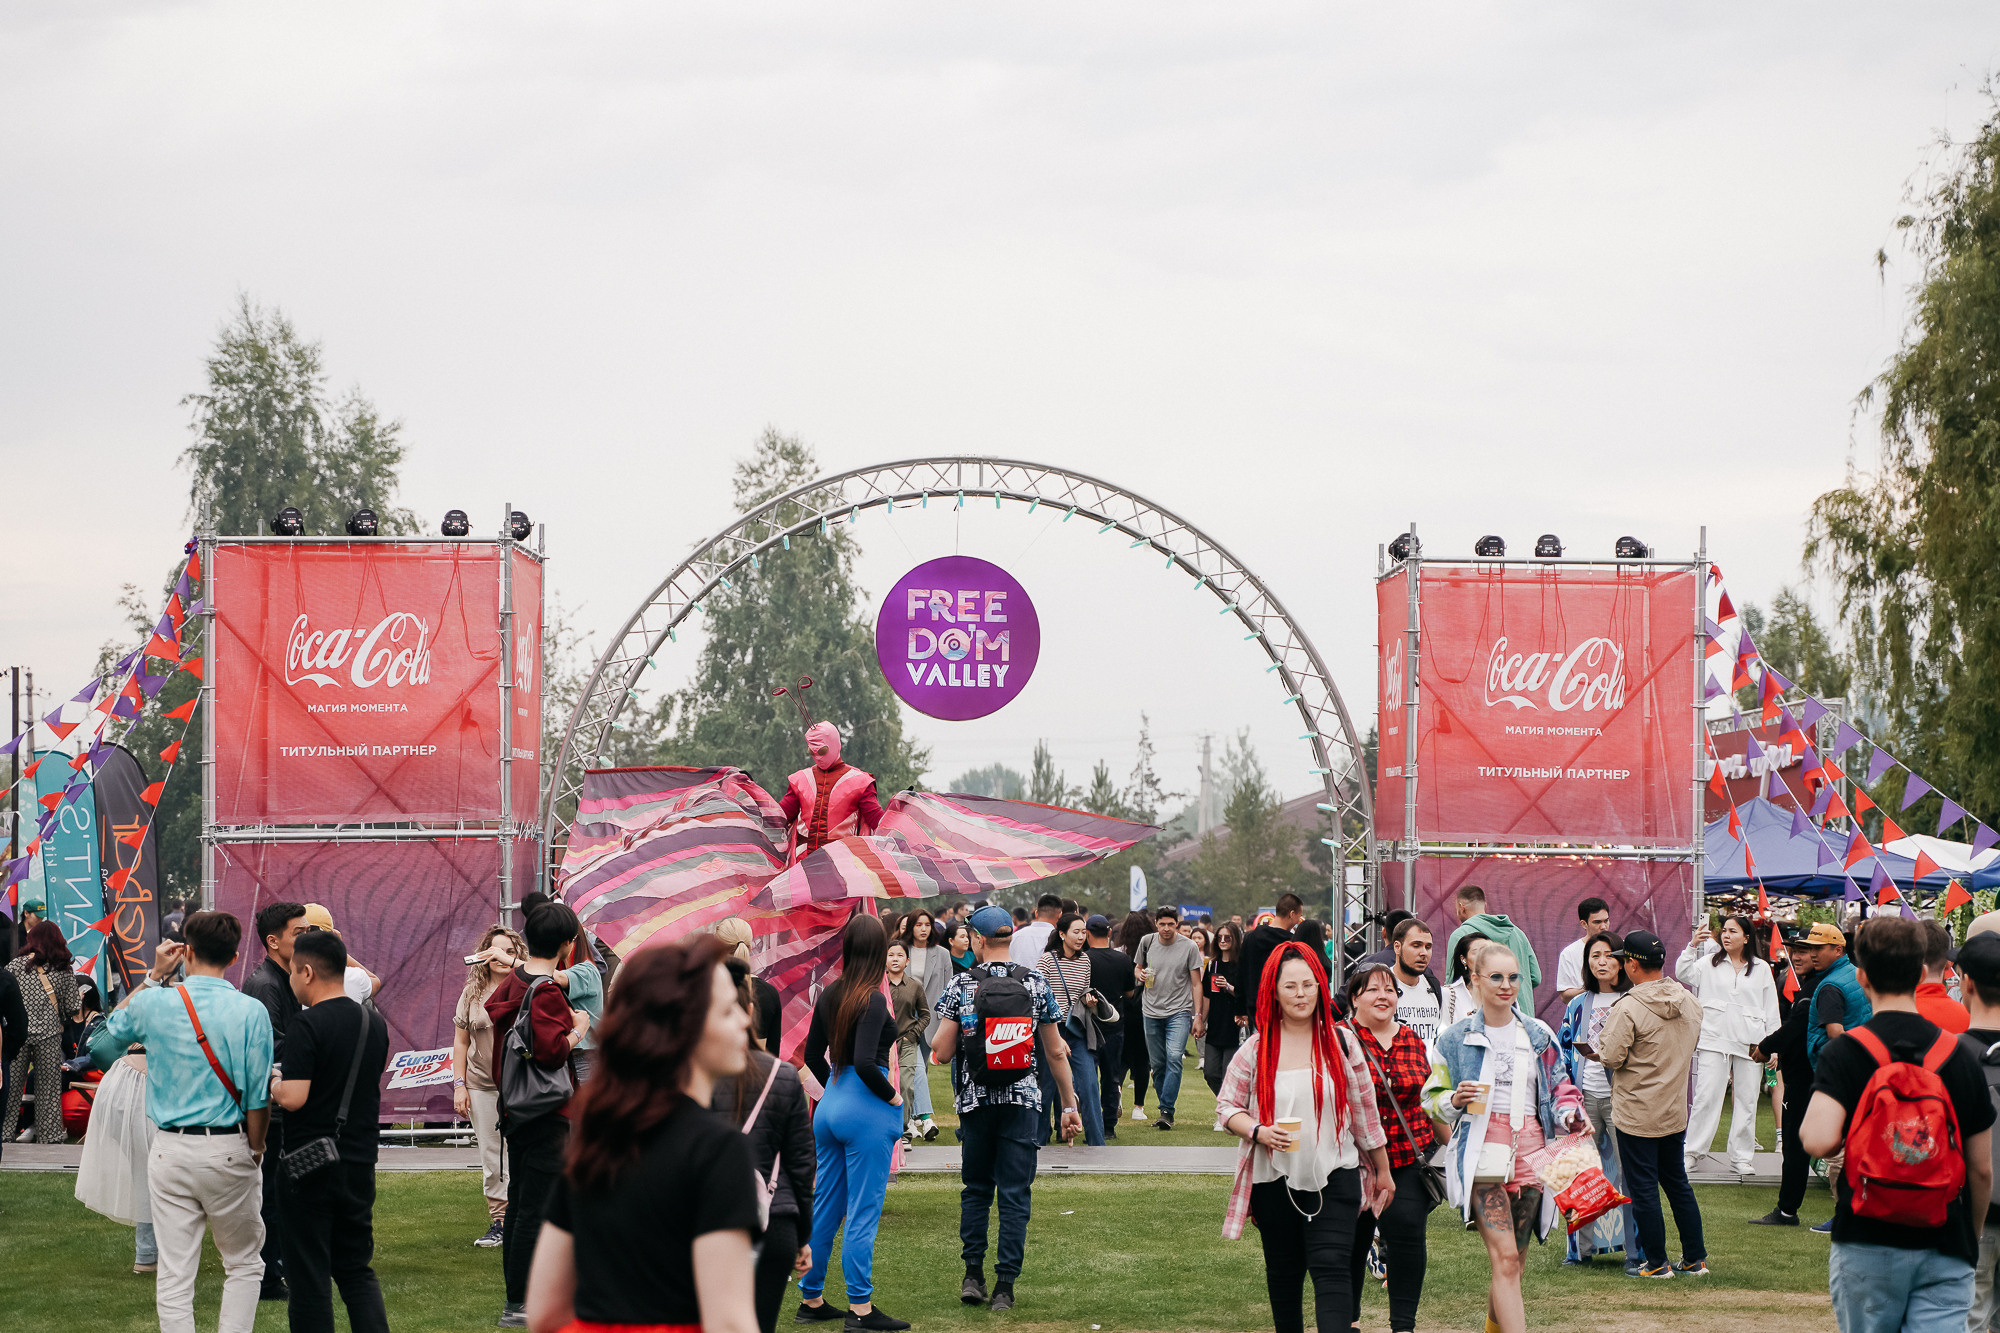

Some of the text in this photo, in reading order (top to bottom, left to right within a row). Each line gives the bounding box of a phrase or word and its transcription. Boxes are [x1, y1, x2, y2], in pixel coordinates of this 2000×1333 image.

[907, 588, 1008, 623] FREE
[284, 611, 431, 689] Coca-Cola
[905, 662, 1010, 688] VALLEY
[1484, 636, 1626, 712] Coca-Cola
[307, 703, 408, 713] МАГИЯ МОМЕНТА
[1505, 725, 1603, 737] МАГИЯ МОМЕНТА
[280, 743, 437, 757] ТИТУЛЬНЫЙ ПАРТНЕР
[1478, 765, 1631, 780] ТИТУЛЬНЫЙ ПАРТНЕР
[1398, 1006, 1438, 1018] ПОРТИВНАЯ
[991, 1023, 1028, 1041] NIKE
[993, 1053, 1030, 1065] AIR
